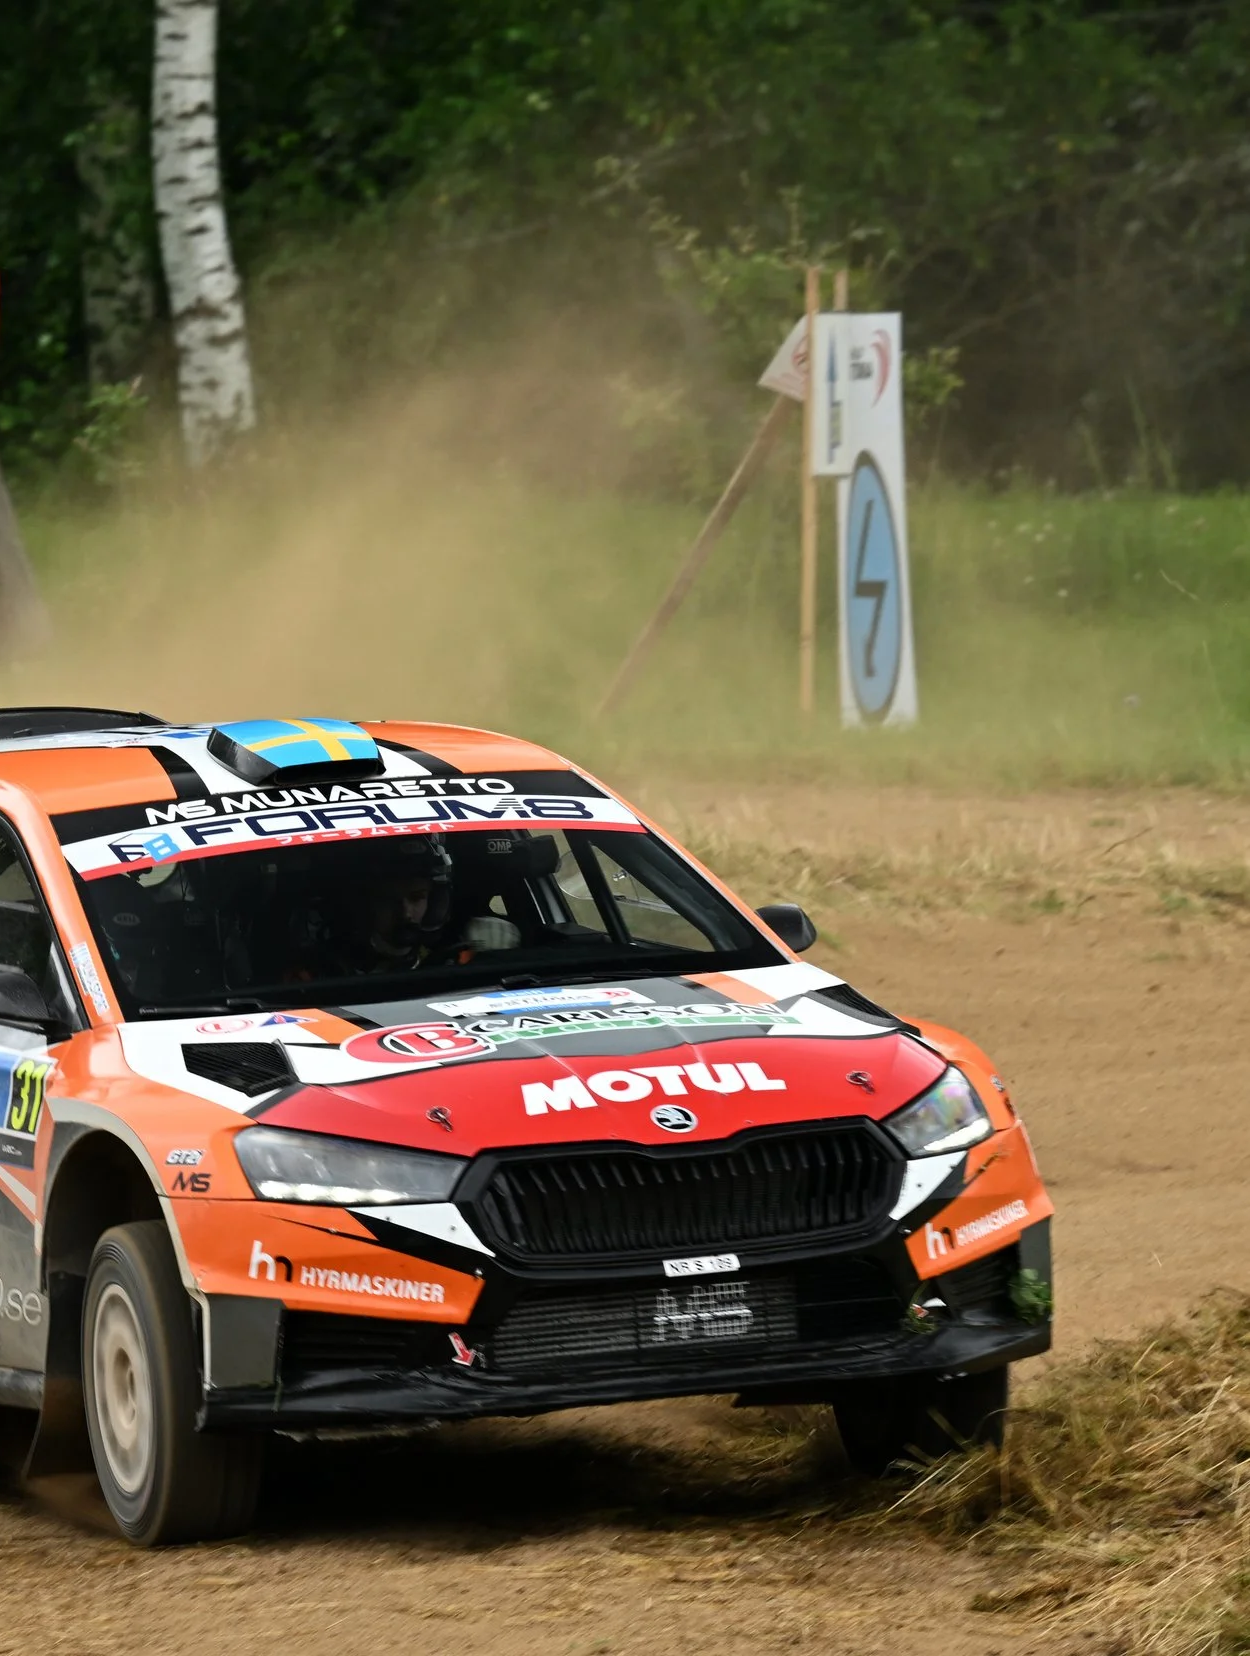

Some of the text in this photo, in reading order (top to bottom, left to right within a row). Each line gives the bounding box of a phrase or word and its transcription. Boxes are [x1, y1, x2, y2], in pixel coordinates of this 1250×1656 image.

[221, 777, 515, 814] MUNARETTO
[181, 797, 594, 846] FORUM8
[274, 822, 455, 845] フォーラムエイト
[487, 839, 512, 853] OMP
[466, 1002, 787, 1036] CARLSSON
[11, 1059, 49, 1134] 31
[521, 1062, 787, 1116] MOTUL
[171, 1170, 212, 1192] MS
[300, 1264, 446, 1305] HYRMASKINER
